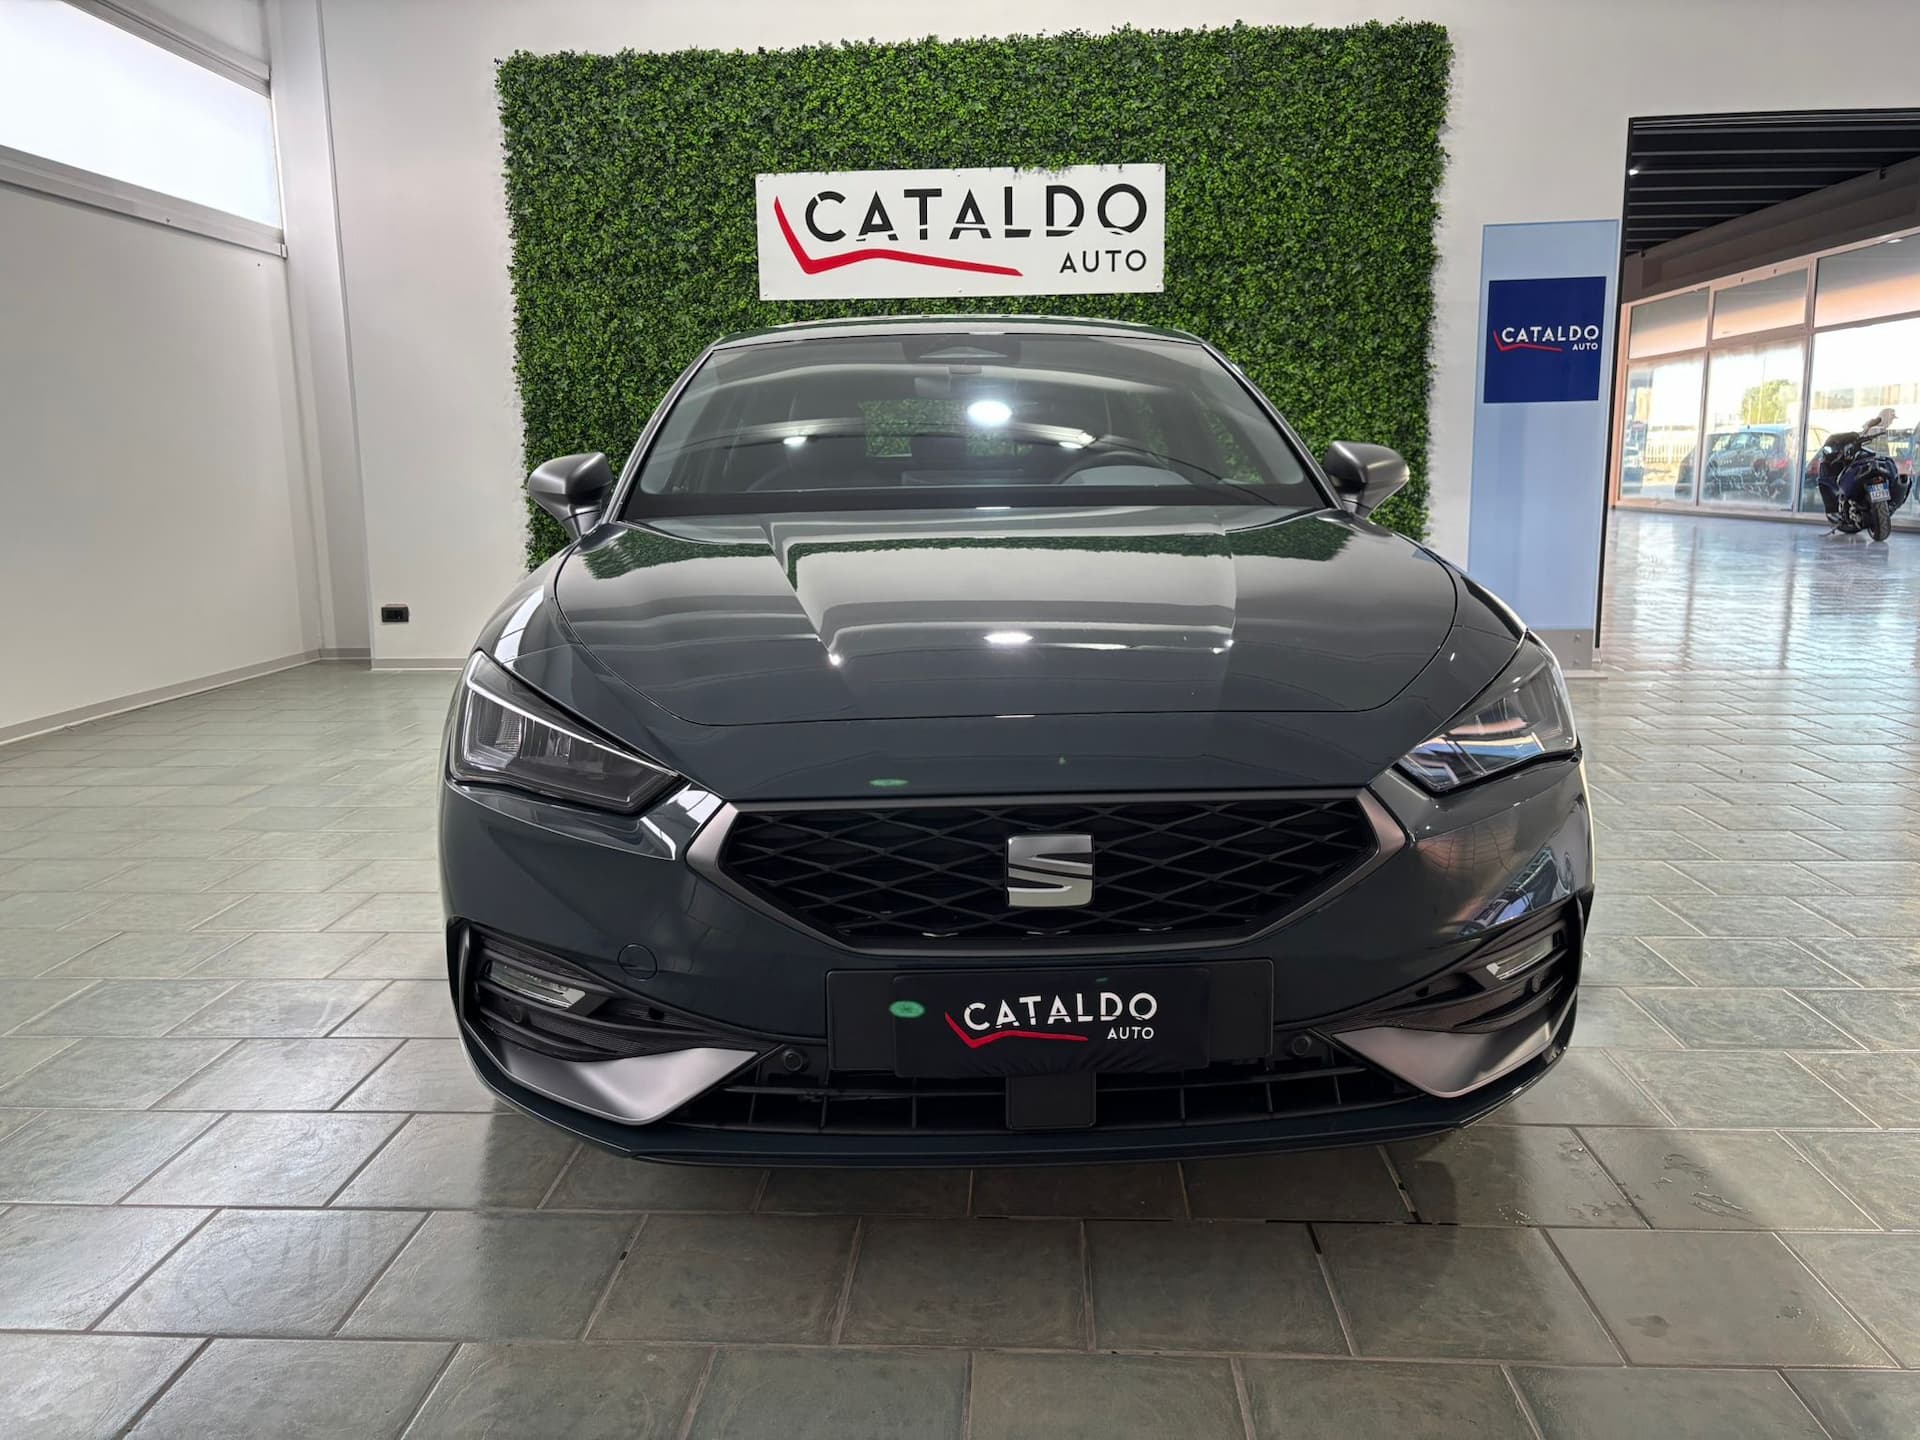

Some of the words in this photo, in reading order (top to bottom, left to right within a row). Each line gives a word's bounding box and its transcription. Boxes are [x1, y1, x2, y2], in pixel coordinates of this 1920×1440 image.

[804, 183, 1148, 242] CATALDO
[1059, 249, 1148, 273] AUTO
[1501, 325, 1600, 343] CATALDO
[1572, 342, 1599, 351] AUTO
[963, 992, 1158, 1031] CATALDO
[1107, 1026, 1155, 1041] AUTO
